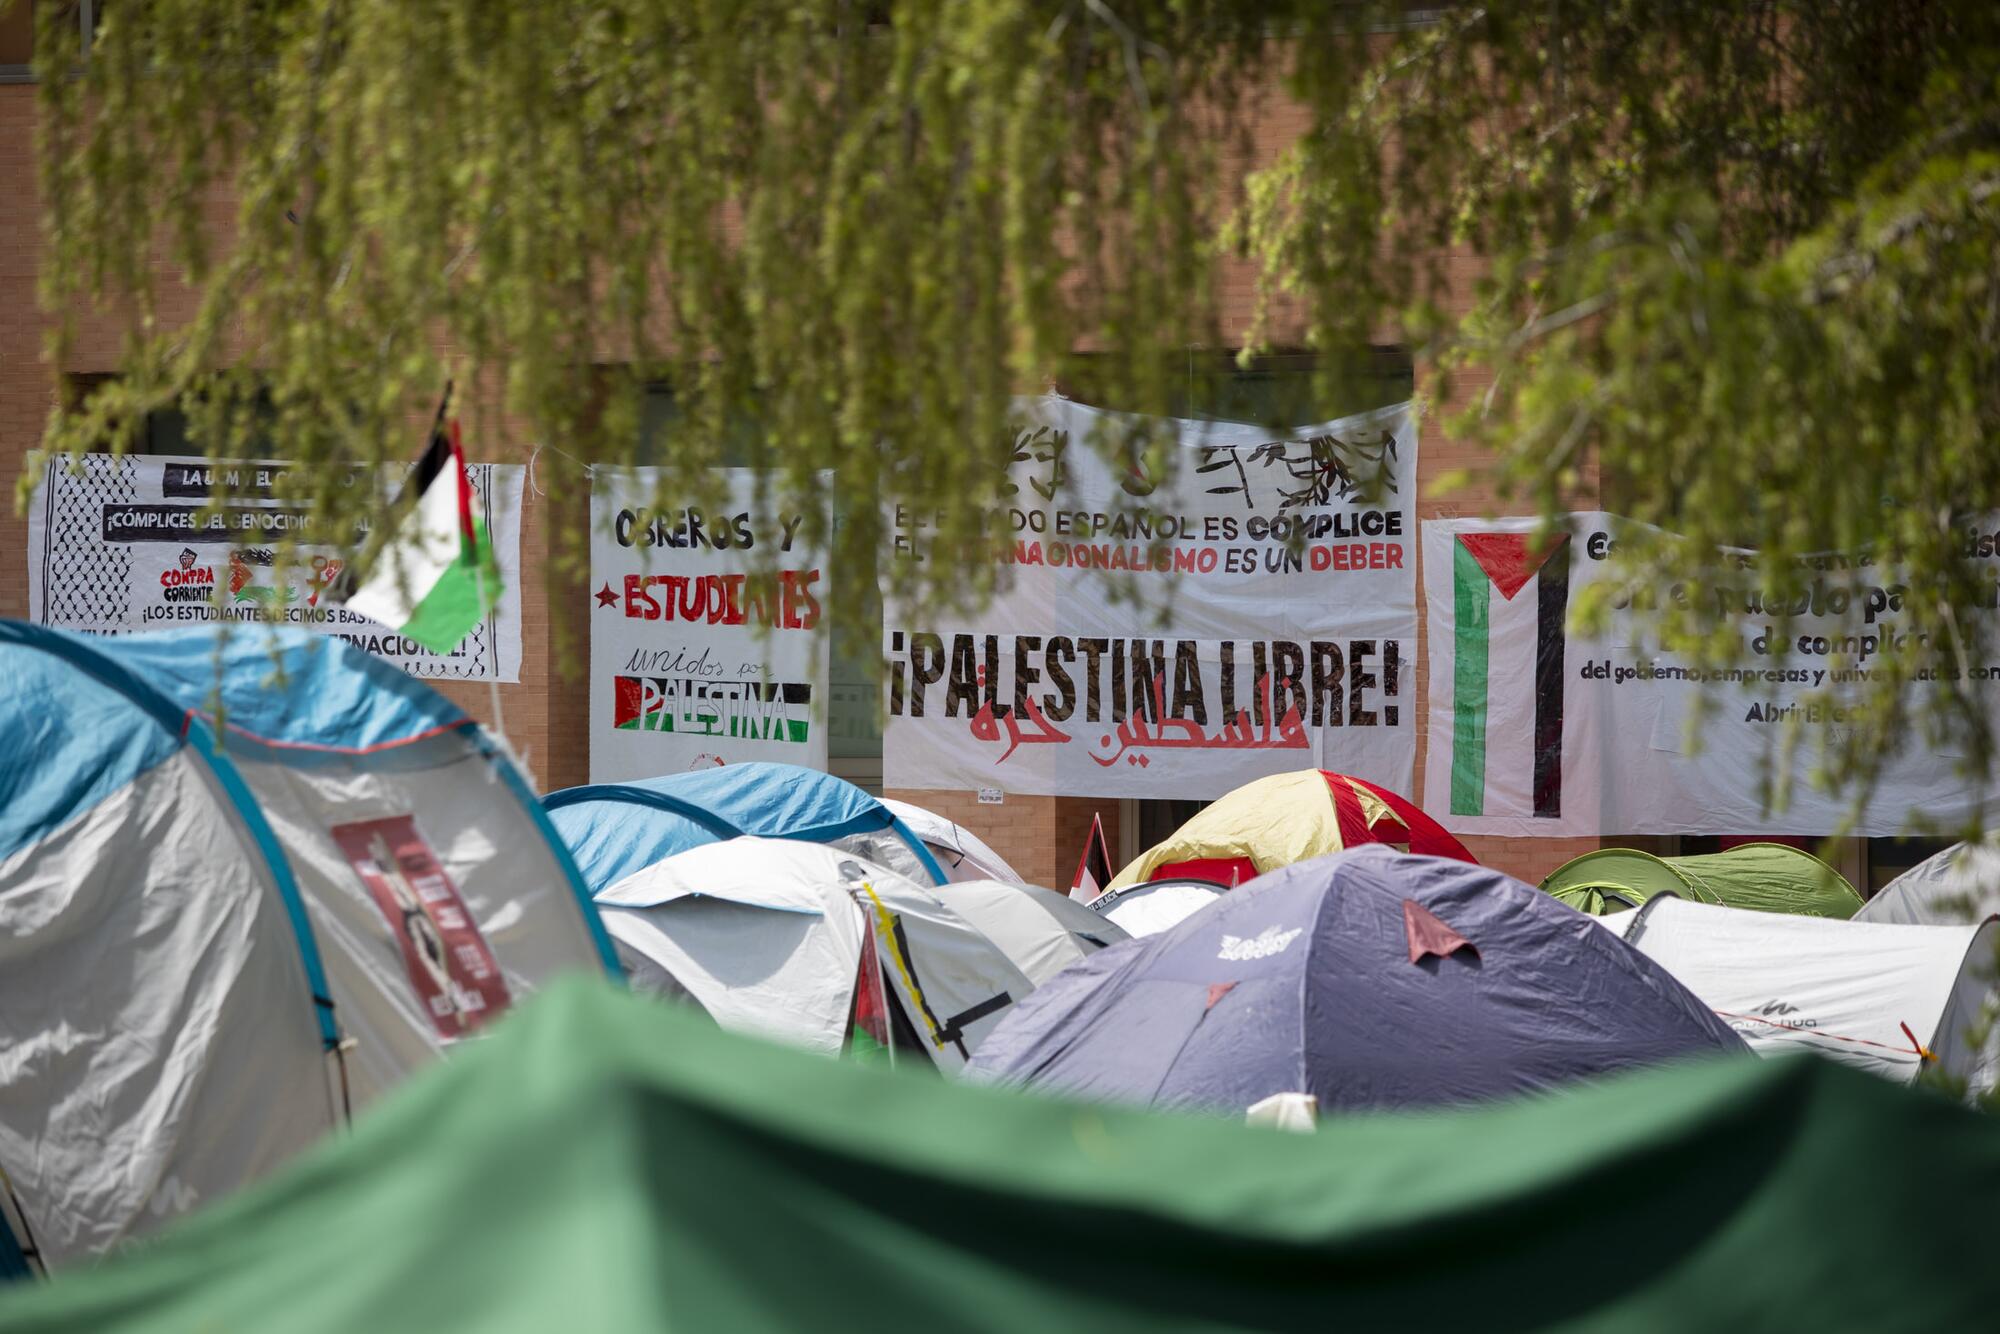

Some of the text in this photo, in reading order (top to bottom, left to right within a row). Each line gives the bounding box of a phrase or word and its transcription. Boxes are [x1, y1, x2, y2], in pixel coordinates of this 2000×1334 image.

[182, 470, 201, 486] LA
[203, 470, 239, 487] UM
[256, 472, 273, 487] EL
[107, 508, 196, 532] ¡CÓMPLICES
[616, 506, 803, 552] OBREROS Y
[1056, 507, 1196, 540] ESPAÑOL
[1204, 517, 1238, 541] ES
[1246, 509, 1402, 541] CÓMPLICE
[935, 538, 1218, 574] NACIONALISMO
[1225, 549, 1257, 574] ES
[1265, 547, 1303, 574] UN
[1310, 543, 1403, 571] DEBER
[160, 565, 214, 588] CONTRA
[164, 586, 213, 602] CORRIENTE
[143, 606, 173, 624] ¡LOS
[177, 606, 270, 622] ESTUDIANTES
[273, 608, 336, 624] DECIMOS
[625, 647, 725, 677] unidos
[1580, 660, 1611, 679] del
[1710, 667, 1808, 688] empresas
[1812, 668, 1826, 687] y
[890, 631, 1400, 727] ¡PALESTINA LIBRE!
[638, 677, 792, 742] PALESTINA
